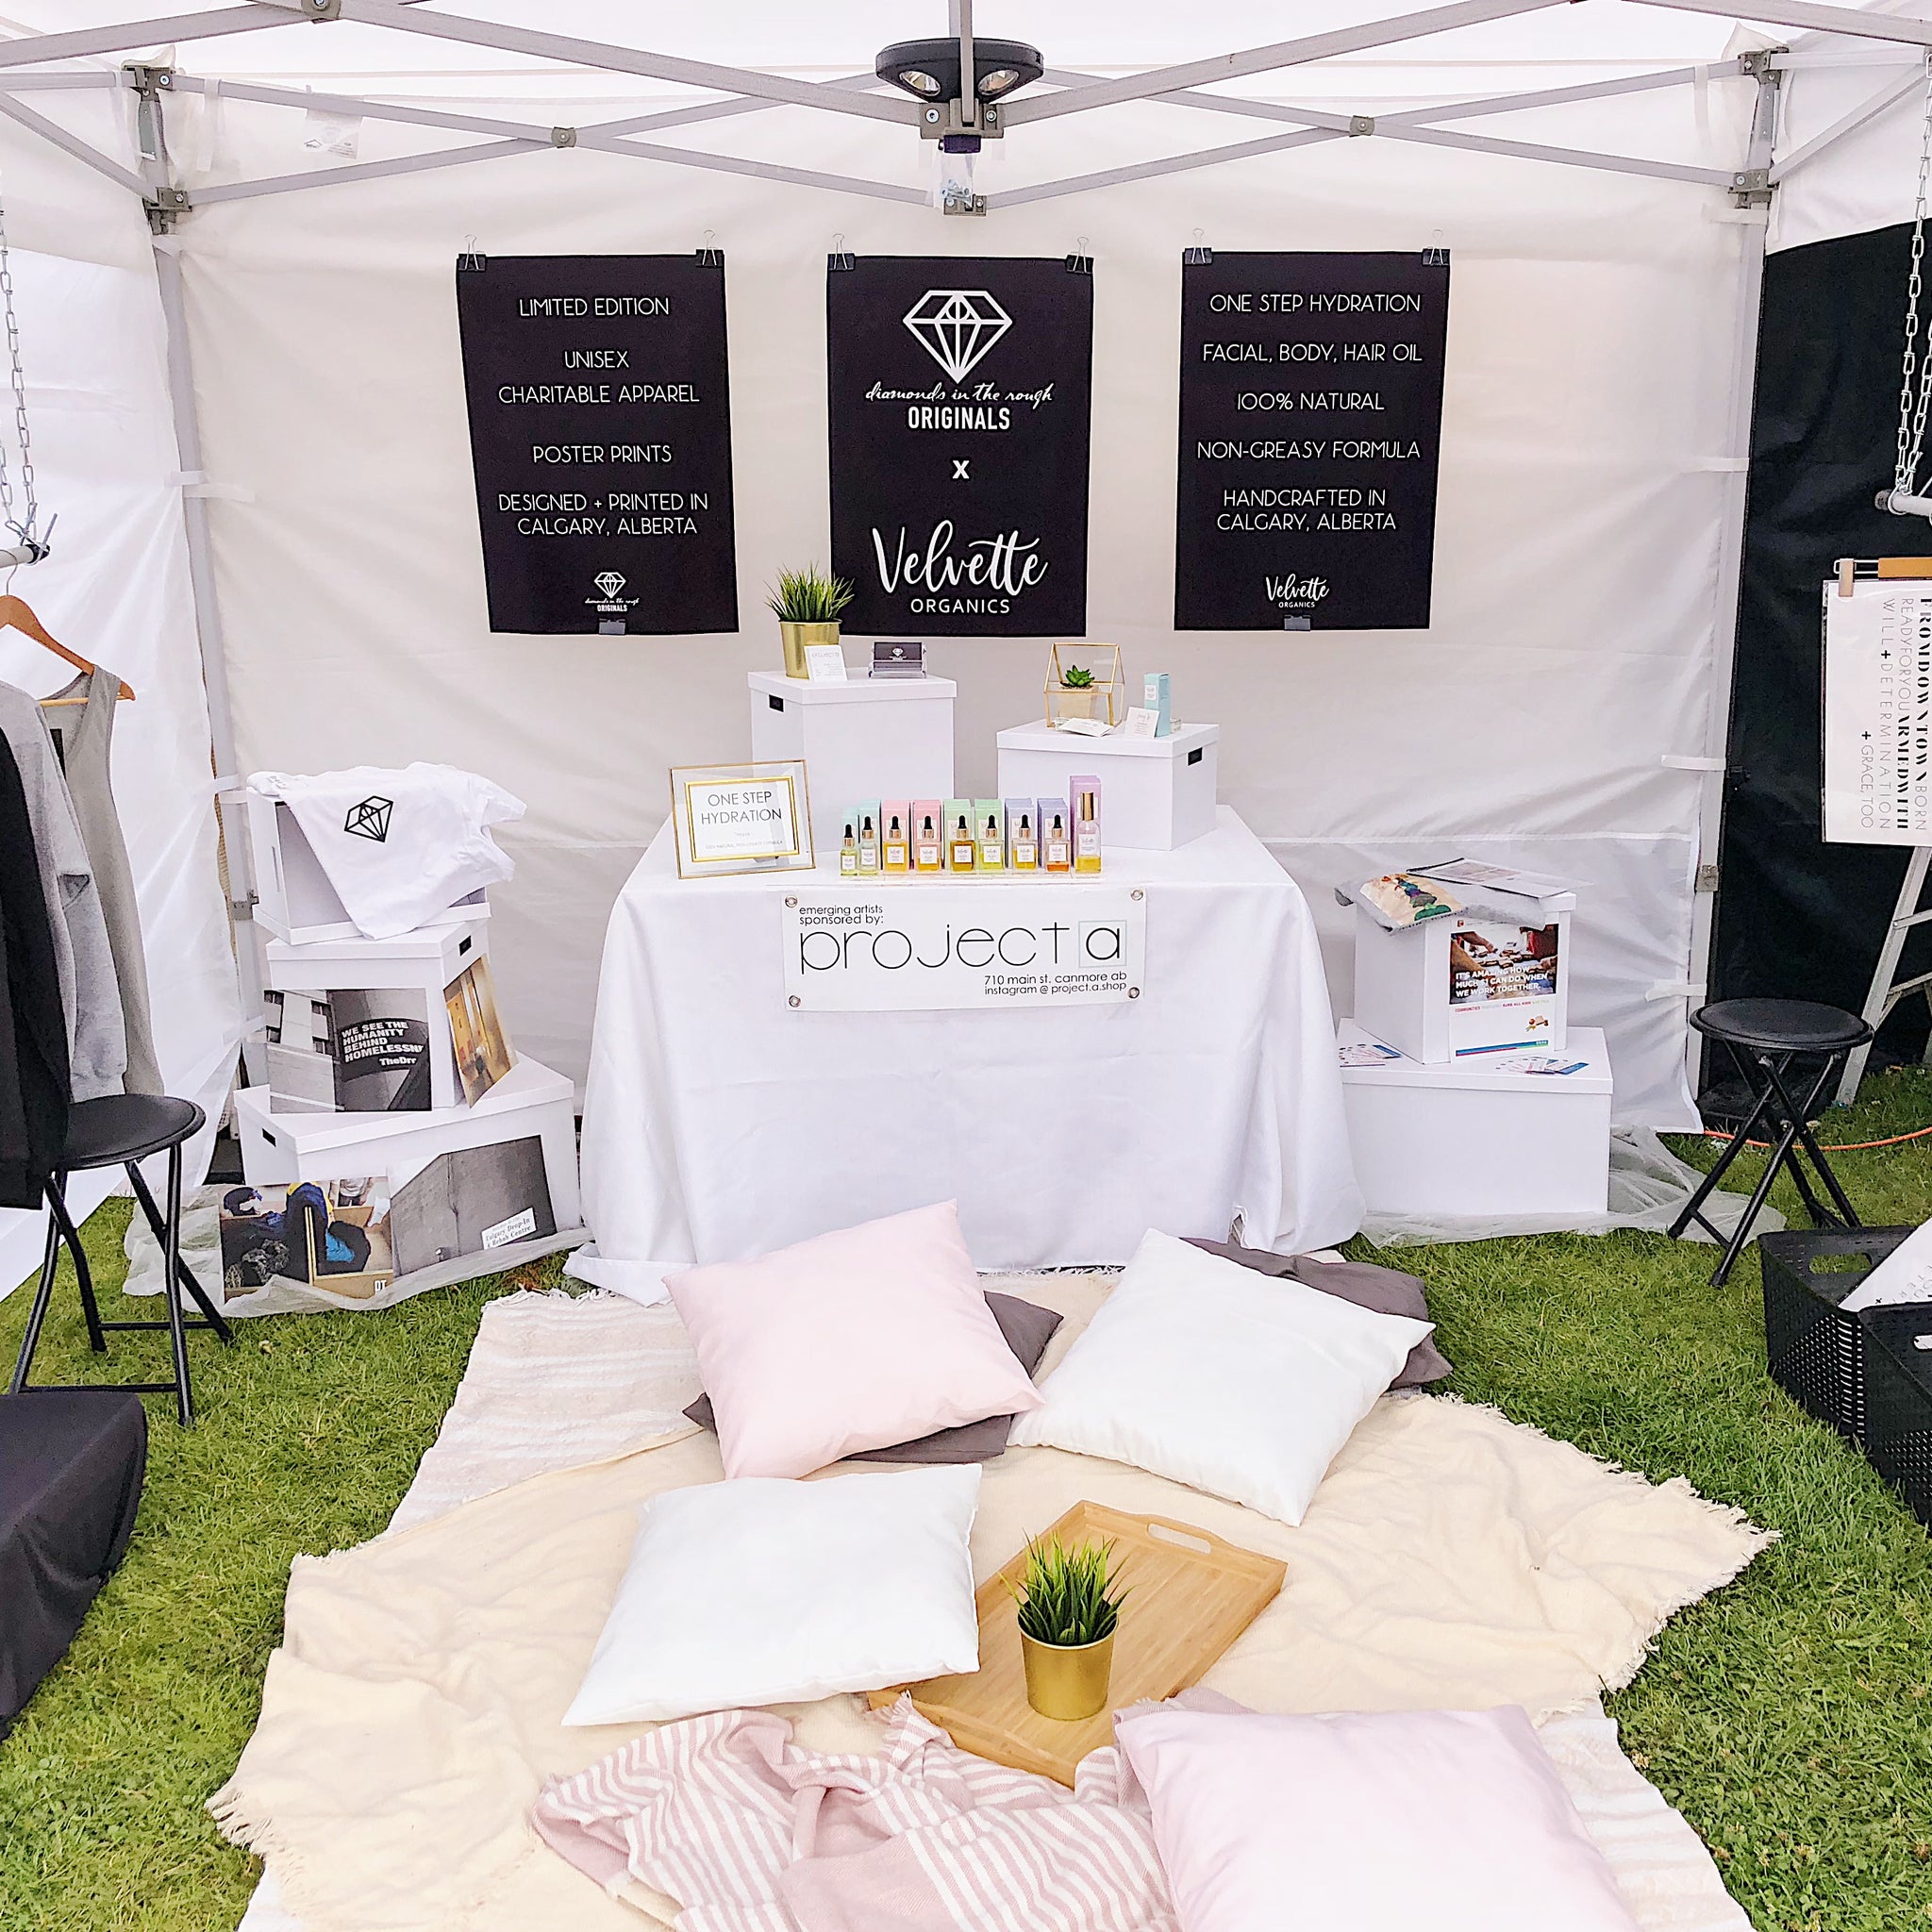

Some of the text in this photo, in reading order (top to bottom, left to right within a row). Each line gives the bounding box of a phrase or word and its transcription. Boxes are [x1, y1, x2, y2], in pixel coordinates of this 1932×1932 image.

[519, 297, 669, 317] LIMITED EDITION
[1209, 293, 1421, 312] ONE STEP HYDRATION
[564, 350, 629, 369] UNISEX
[1203, 343, 1423, 363] FACIAL, BODY, HAIR OIL
[498, 384, 700, 404] CHARITABLE APPAREL
[865, 381, 1055, 410] diamonds in the rough
[1238, 392, 1385, 410] 100% NATURAL
[908, 406, 1010, 430] ORIGINALS
[533, 444, 672, 463] POSTER PRINTS
[1197, 441, 1421, 458] NON-GREASY FORMULA
[498, 493, 708, 511] DESIGNED + PRINTED IN
[1224, 489, 1386, 507] HANDCRAFTED IN
[517, 517, 698, 537] CALGARY, ALBERTA
[1217, 512, 1396, 532] CALGARY, ALBERTA
[872, 519, 1048, 597] Velvette
[1265, 573, 1330, 601] Velvette
[596, 604, 628, 612] ORIGINALS
[910, 597, 1010, 614] ORGANICS
[708, 791, 772, 807] ONE STEP
[701, 808, 782, 825] HYDRATION
[1861, 798, 1874, 828] TOO
[799, 905, 883, 916] emerging artists
[799, 914, 884, 926] sponsored by:
[799, 921, 1121, 975] project a
[984, 971, 1127, 985] 710 main st. canmore ab
[1472, 968, 1508, 978] AMAZING
[1510, 965, 1530, 974] HOW
[984, 982, 1127, 997] instagram @ project.a.shop
[1456, 980, 1478, 989] MUCH
[1456, 990, 1470, 999] WE
[1471, 987, 1495, 996] WORK
[341, 1021, 409, 1039] WE SEE THE
[342, 1029, 405, 1046] HUMANITY
[343, 1038, 388, 1054] BEHIND
